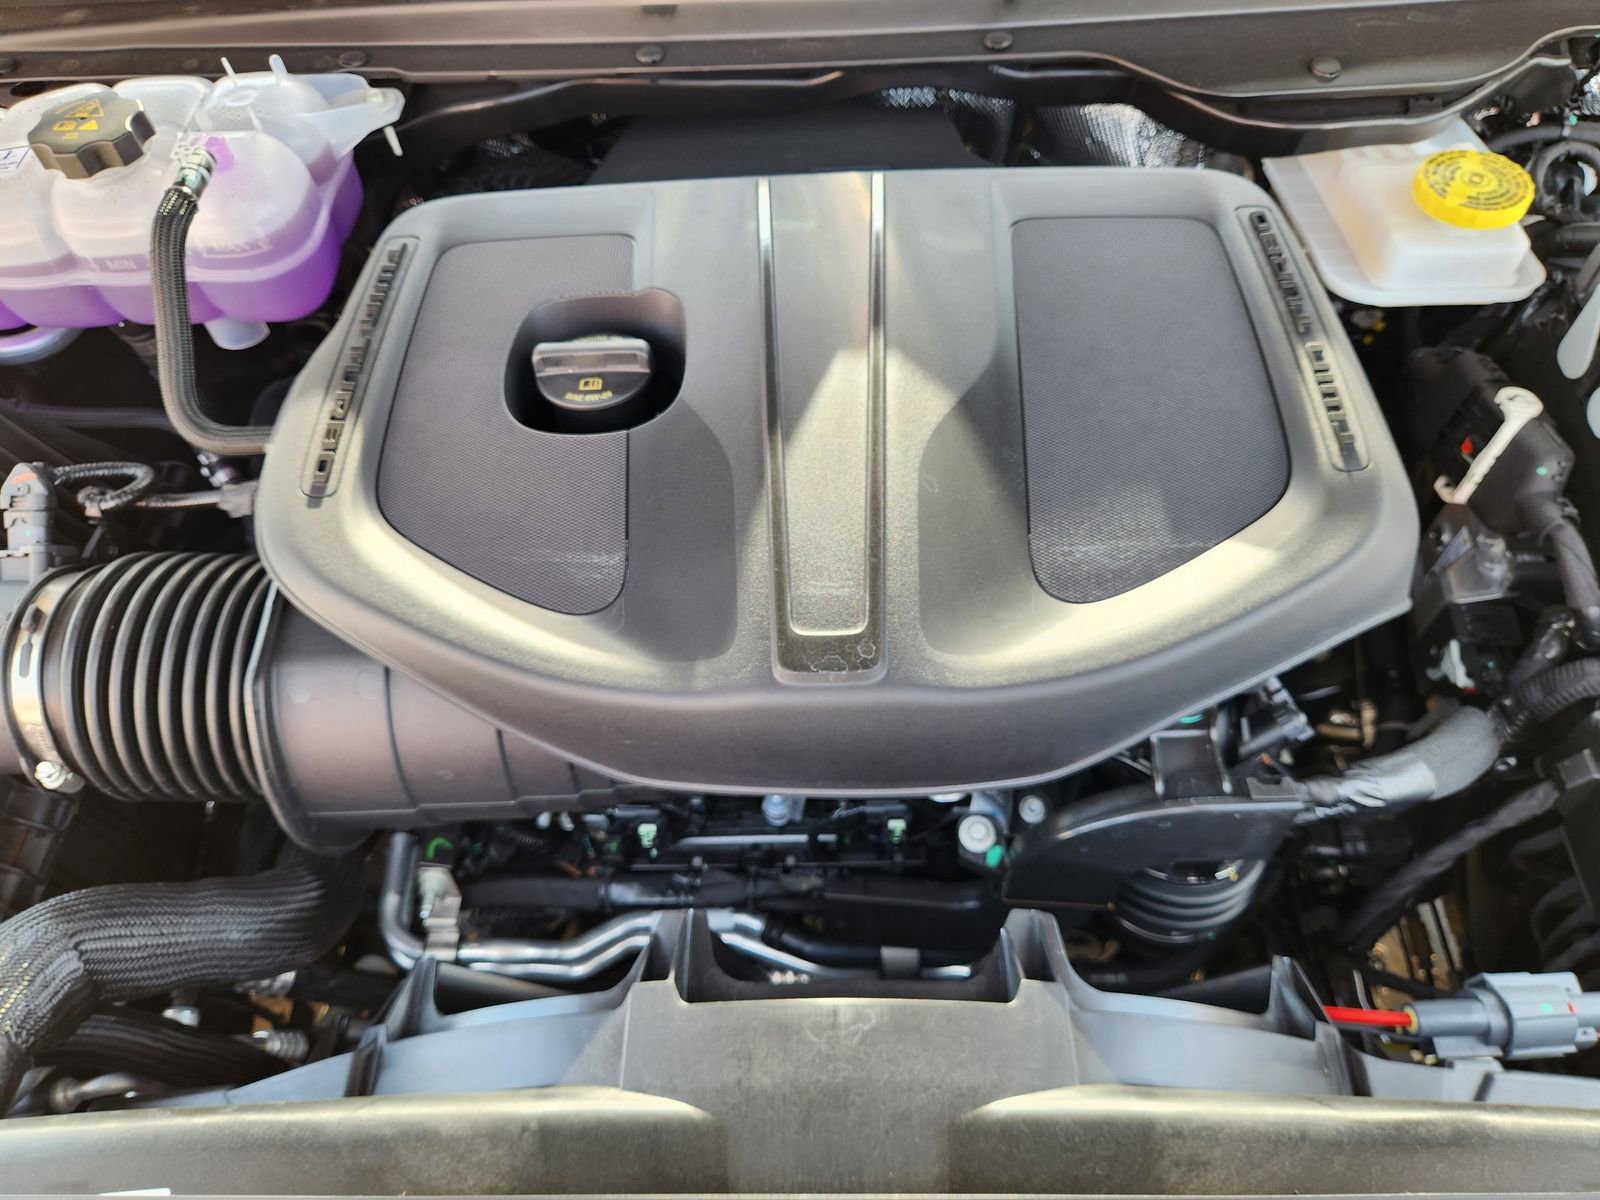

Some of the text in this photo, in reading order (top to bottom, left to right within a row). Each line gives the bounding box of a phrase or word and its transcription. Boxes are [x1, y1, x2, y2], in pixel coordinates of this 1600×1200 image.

[105, 259, 137, 271] MIN
[1250, 211, 1355, 447] TWIN TURBO
[313, 339, 370, 483] TURBO
